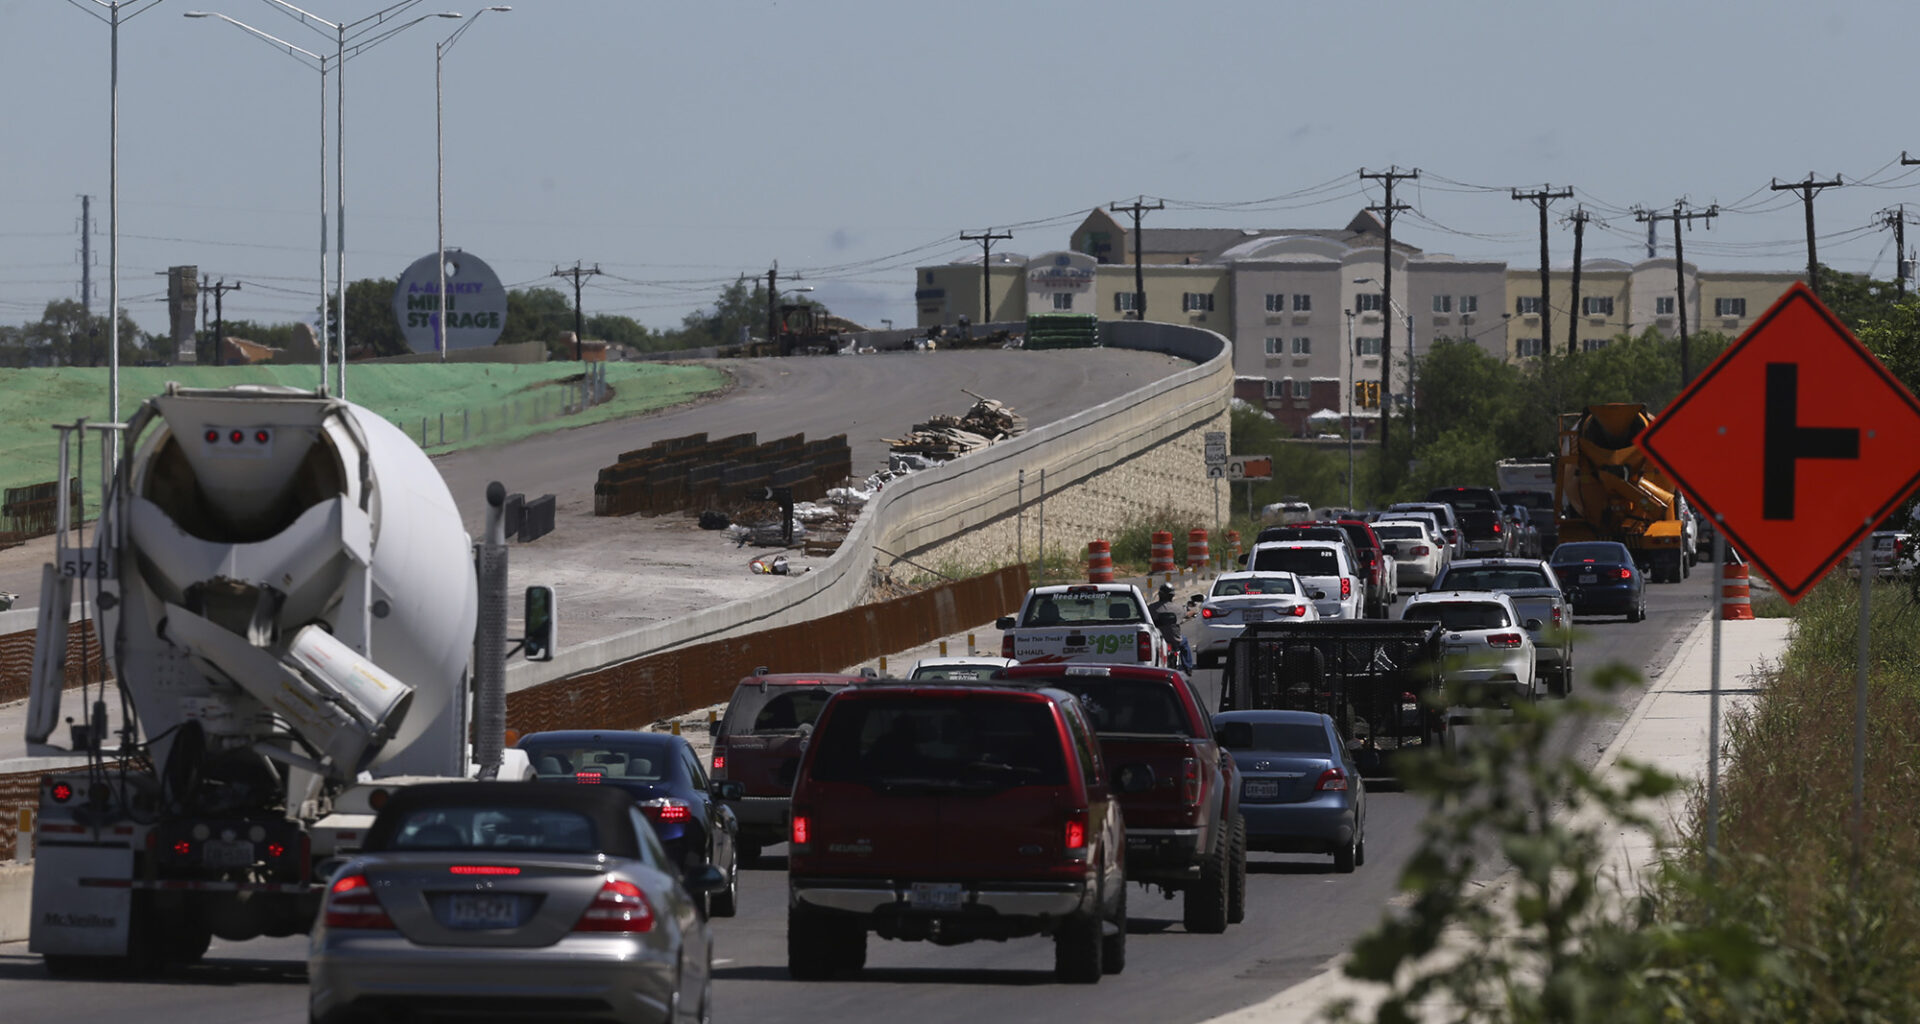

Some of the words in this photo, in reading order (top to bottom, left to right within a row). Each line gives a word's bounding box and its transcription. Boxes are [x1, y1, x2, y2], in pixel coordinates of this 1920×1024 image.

[407, 294, 456, 310] MINI
[1080, 591, 1111, 600] Pickup?
[1063, 646, 1090, 654] GMC
